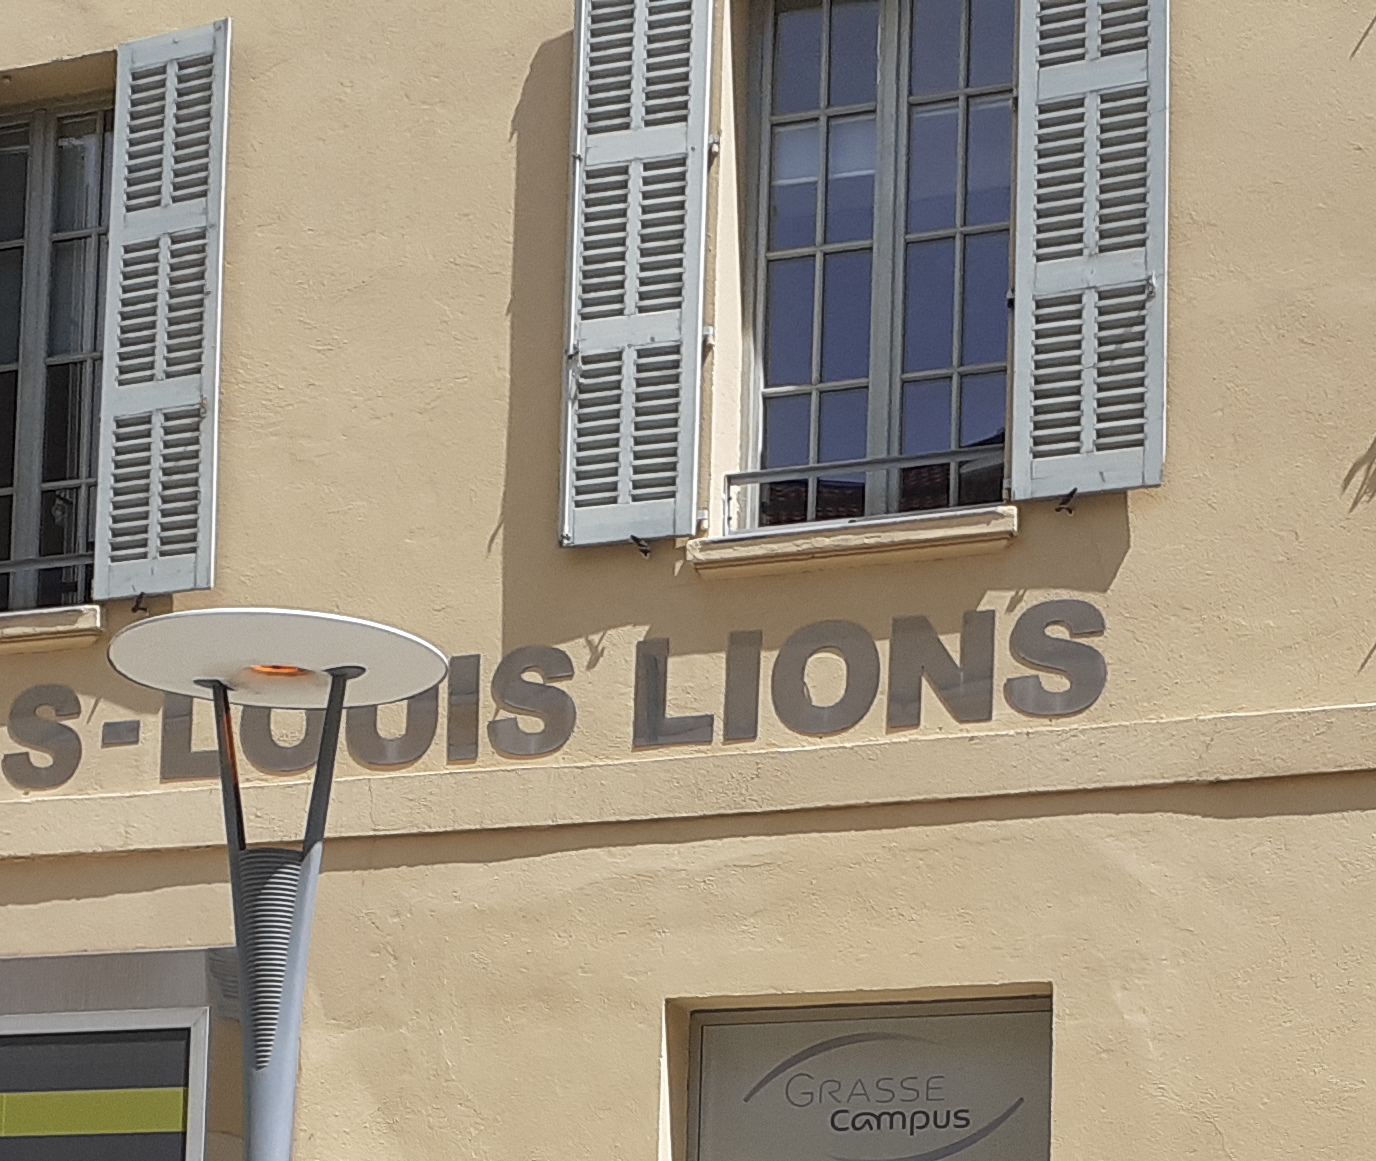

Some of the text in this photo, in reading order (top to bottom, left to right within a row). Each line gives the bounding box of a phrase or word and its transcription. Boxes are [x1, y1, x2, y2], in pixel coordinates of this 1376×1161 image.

[631, 600, 1109, 751] LIONS
[785, 1073, 945, 1107] GRASSE
[830, 1109, 970, 1135] campus
